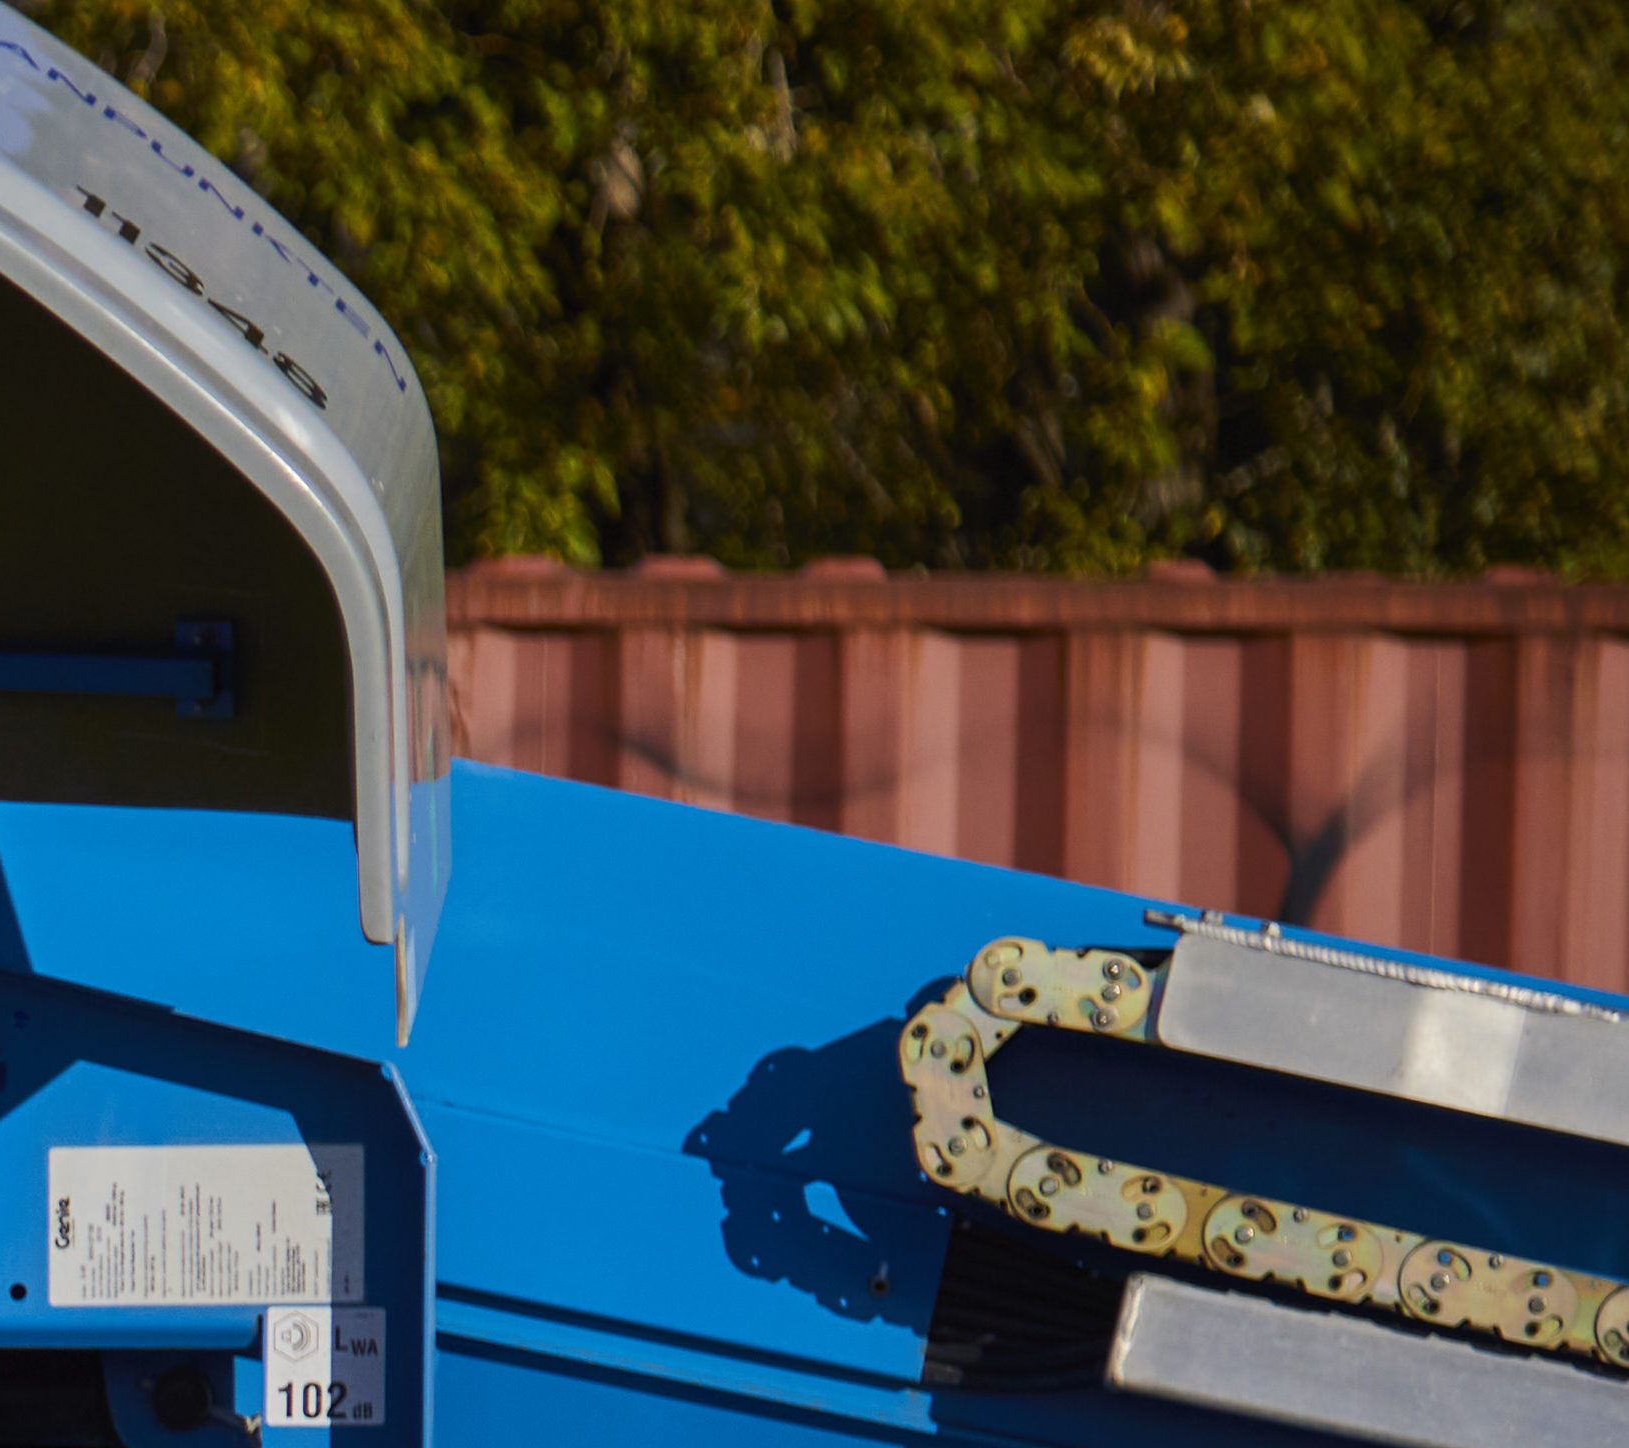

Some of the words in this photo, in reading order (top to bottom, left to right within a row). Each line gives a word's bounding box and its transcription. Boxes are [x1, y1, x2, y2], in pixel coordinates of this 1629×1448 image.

[76, 183, 329, 411] 11348
[55, 1196, 71, 1250] Genie
[278, 1381, 348, 1419] 102
